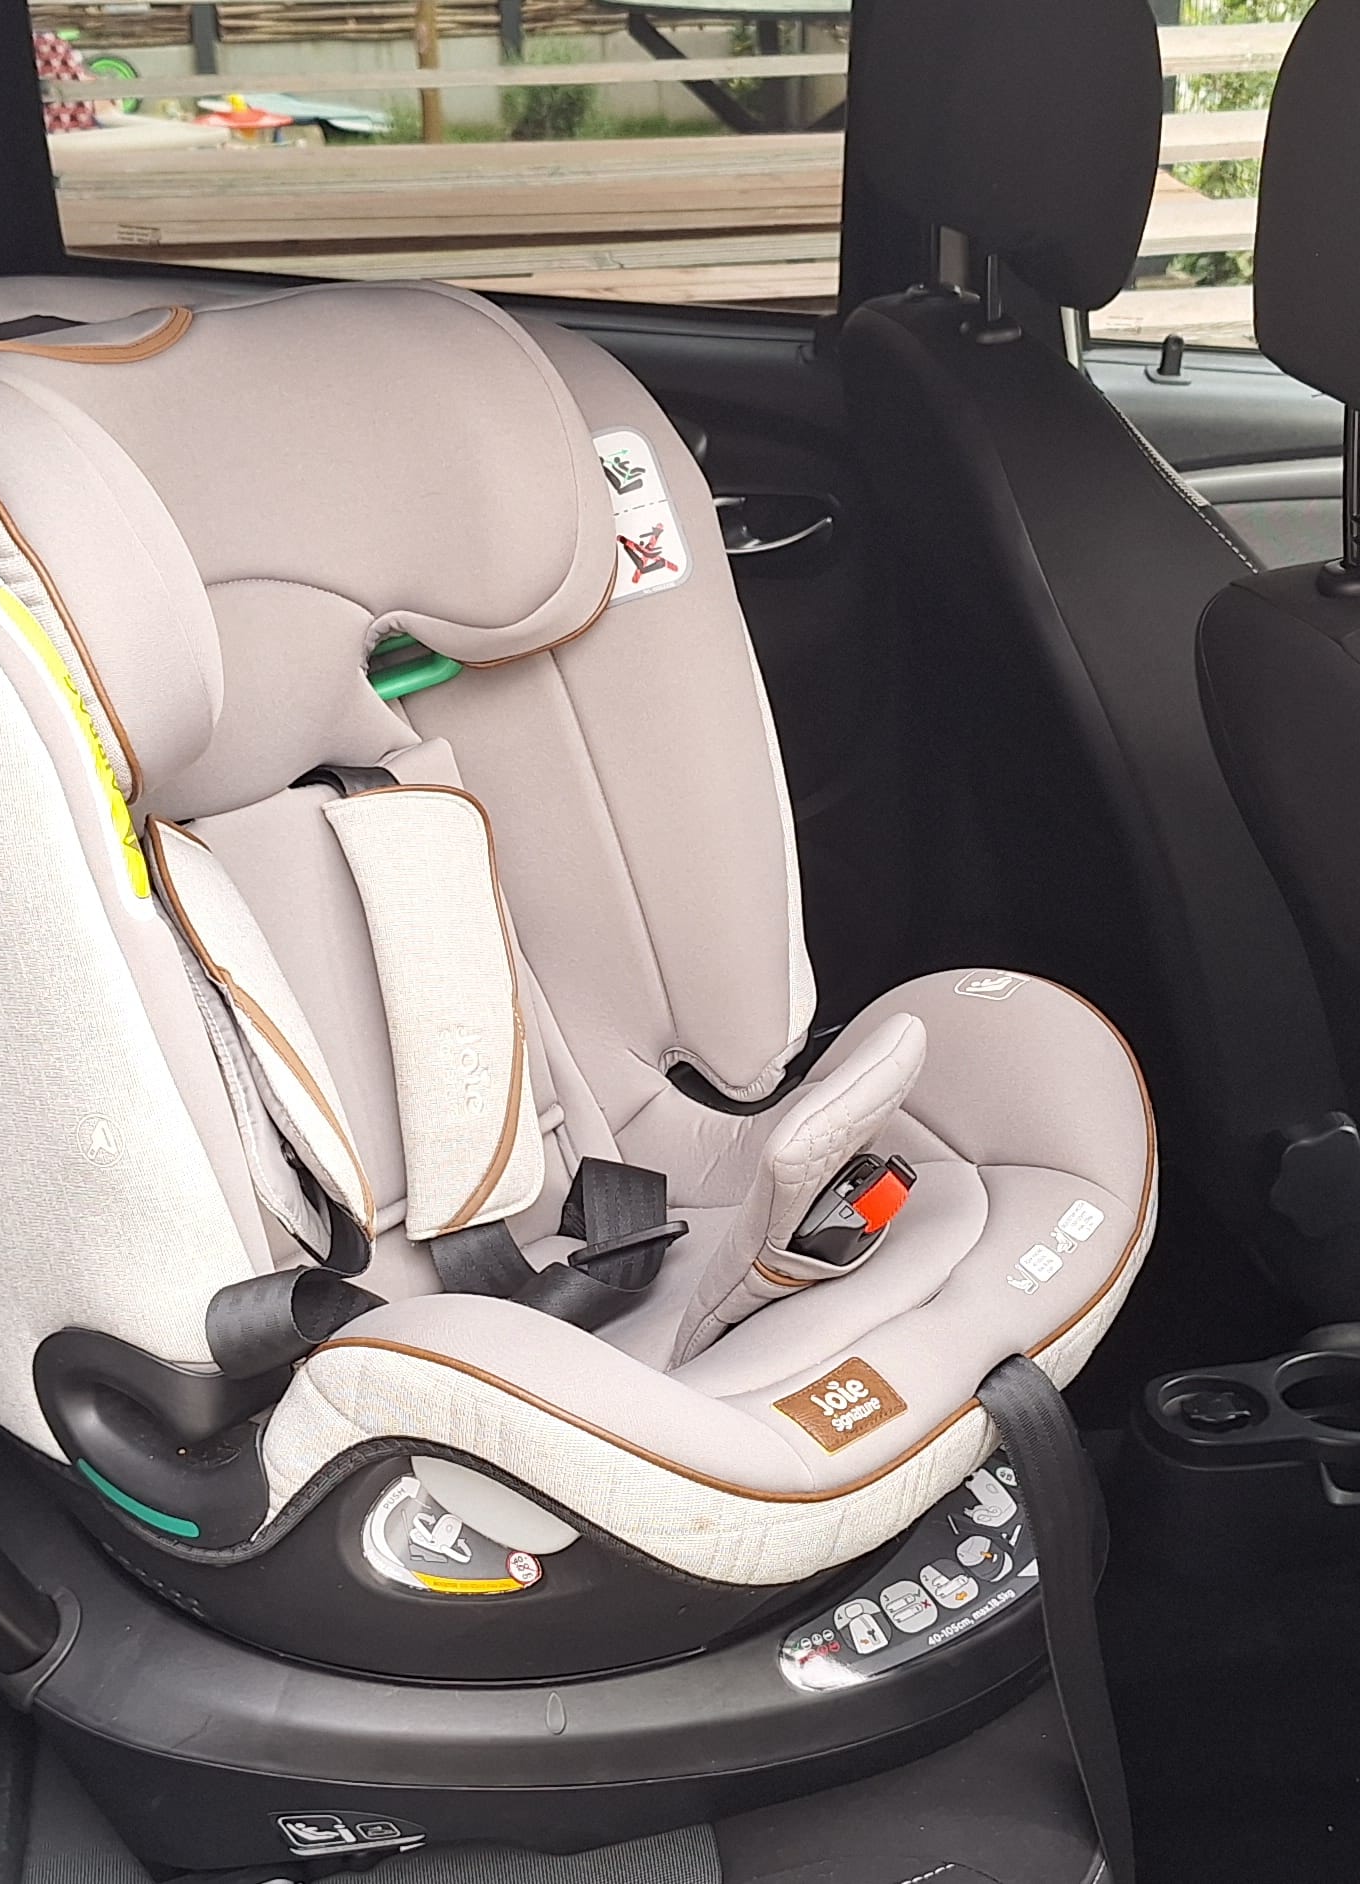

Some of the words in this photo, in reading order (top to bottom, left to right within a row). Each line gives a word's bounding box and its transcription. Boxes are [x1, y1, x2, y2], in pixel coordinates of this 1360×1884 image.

[809, 1379, 869, 1416] Joie
[831, 1397, 882, 1432] signature
[382, 1487, 407, 1510] PUSH
[927, 1616, 976, 1646] 40-105cm,
